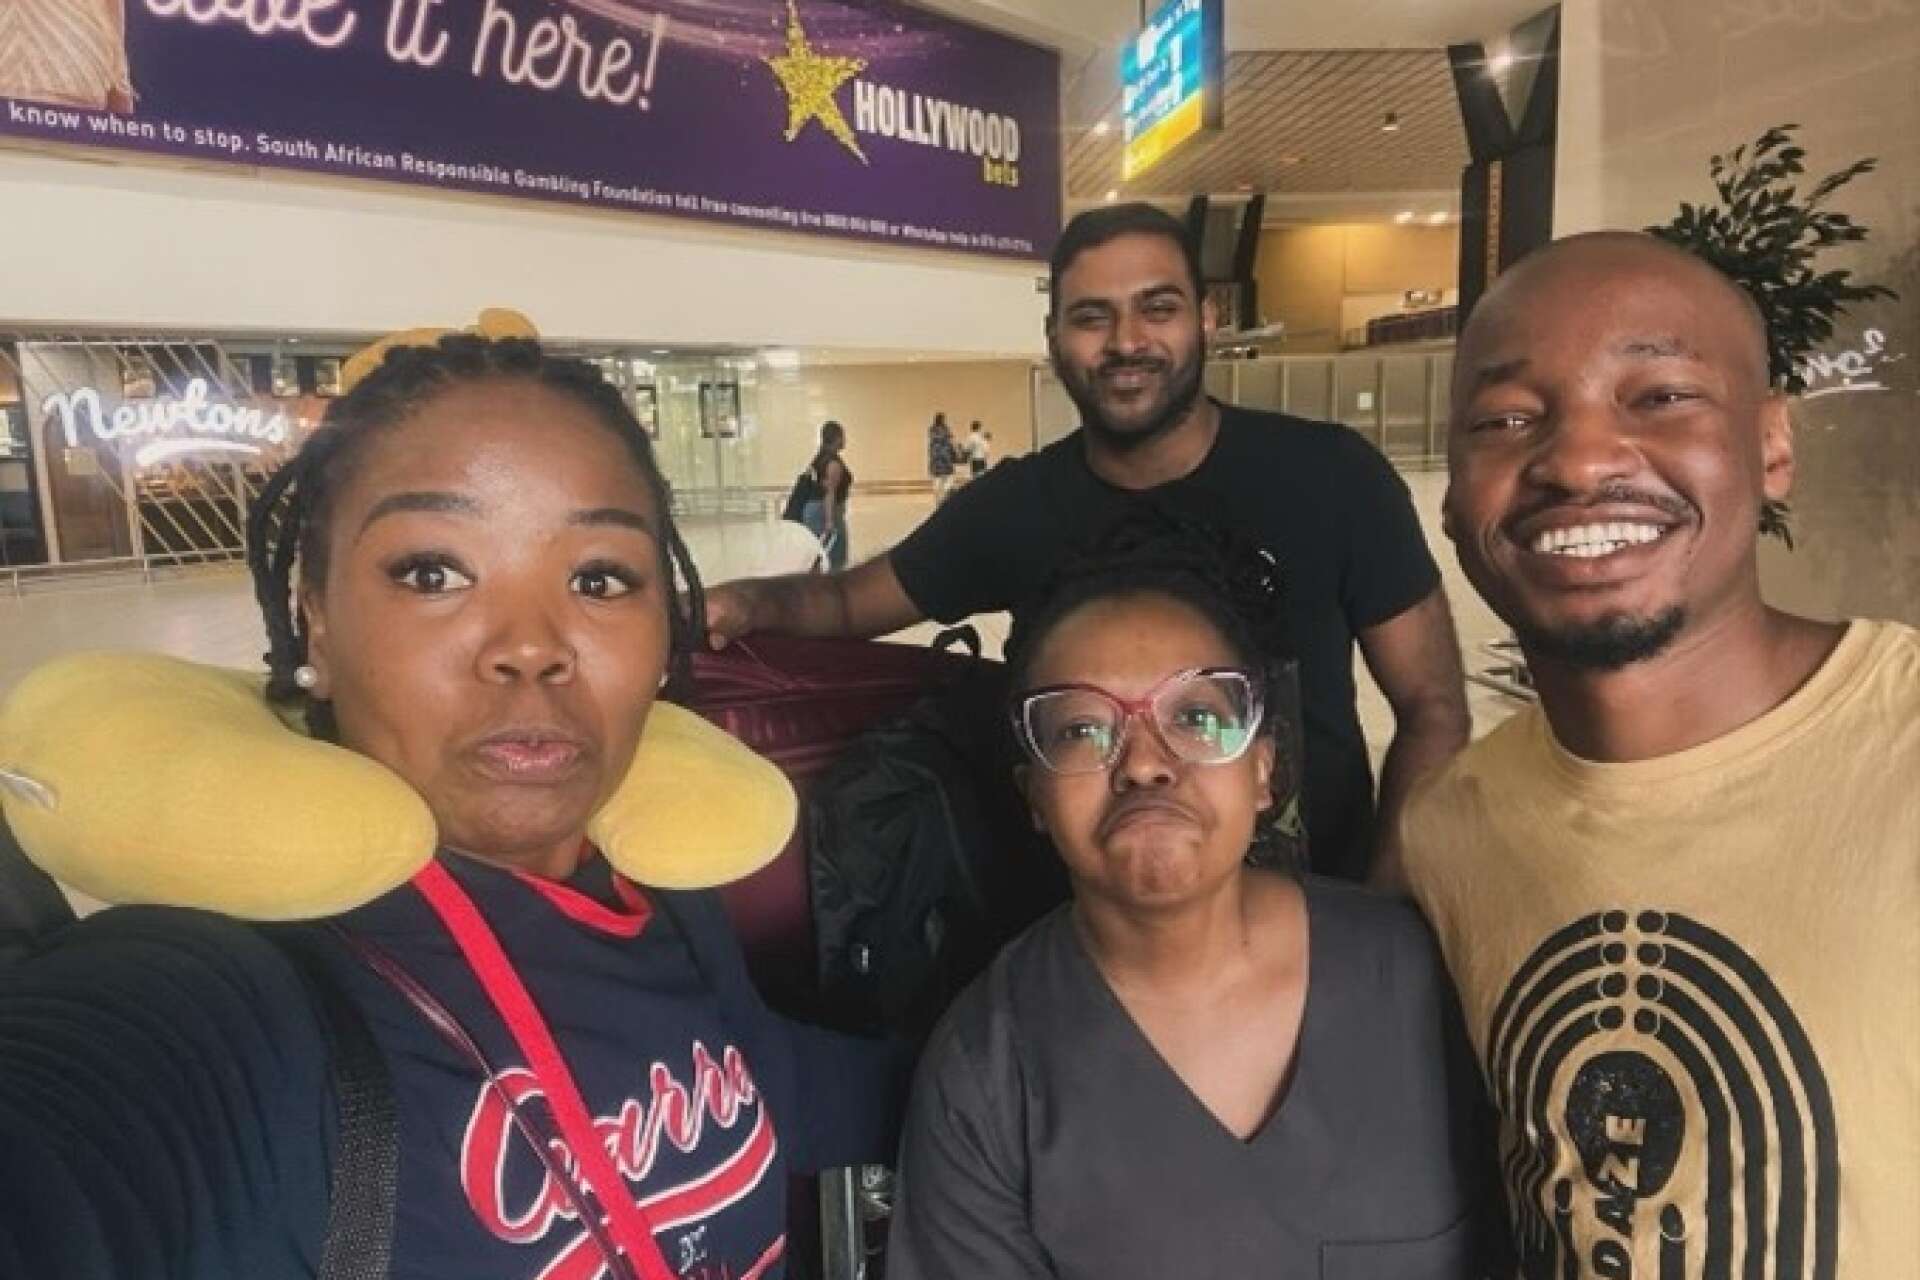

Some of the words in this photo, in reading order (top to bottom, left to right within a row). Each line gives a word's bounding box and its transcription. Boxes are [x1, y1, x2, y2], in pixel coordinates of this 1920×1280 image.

[8, 100, 80, 128] know
[88, 112, 154, 140] when
[163, 120, 186, 143] to
[194, 127, 250, 154] stop.
[256, 132, 318, 160] South
[324, 142, 397, 170] African
[400, 152, 510, 184] Responsible
[514, 168, 589, 199] Gambling
[593, 180, 673, 207] Foundation
[854, 78, 1020, 162] HOLLYWOOD
[43, 378, 290, 448] Newtons
